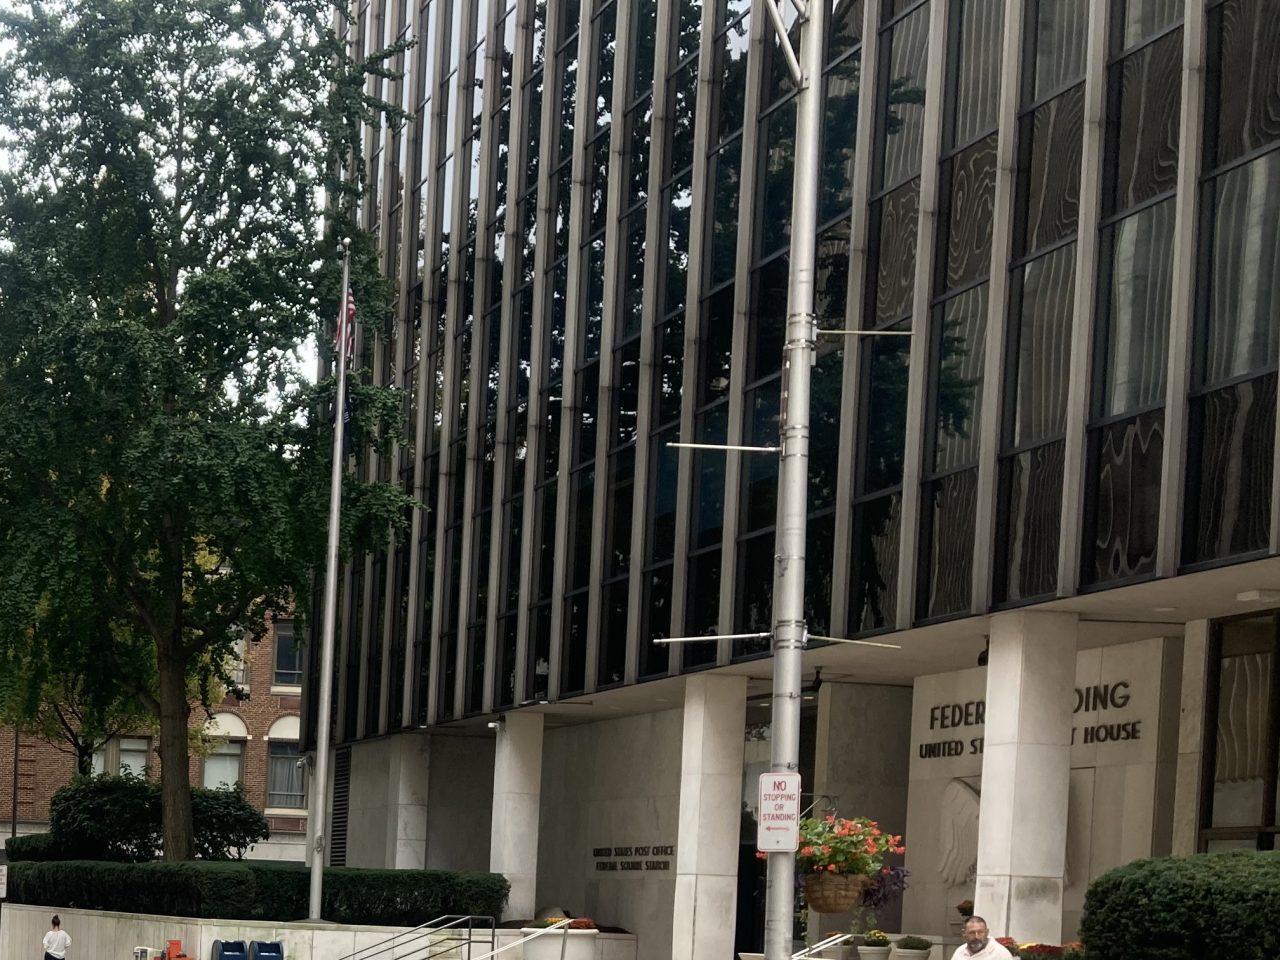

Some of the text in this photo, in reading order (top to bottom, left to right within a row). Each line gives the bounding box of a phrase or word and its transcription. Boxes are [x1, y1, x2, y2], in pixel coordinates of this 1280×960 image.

[929, 681, 1131, 730] FEDER DING
[919, 740, 965, 759] UNITED
[1083, 720, 1142, 744] HOUSE
[773, 780, 787, 792] NO
[763, 793, 796, 802] STOPPING
[774, 803, 785, 811] OR
[762, 813, 796, 822] STANDING
[593, 845, 675, 857] UNITED STATES POST OFFICE
[645, 860, 670, 871] STATION
